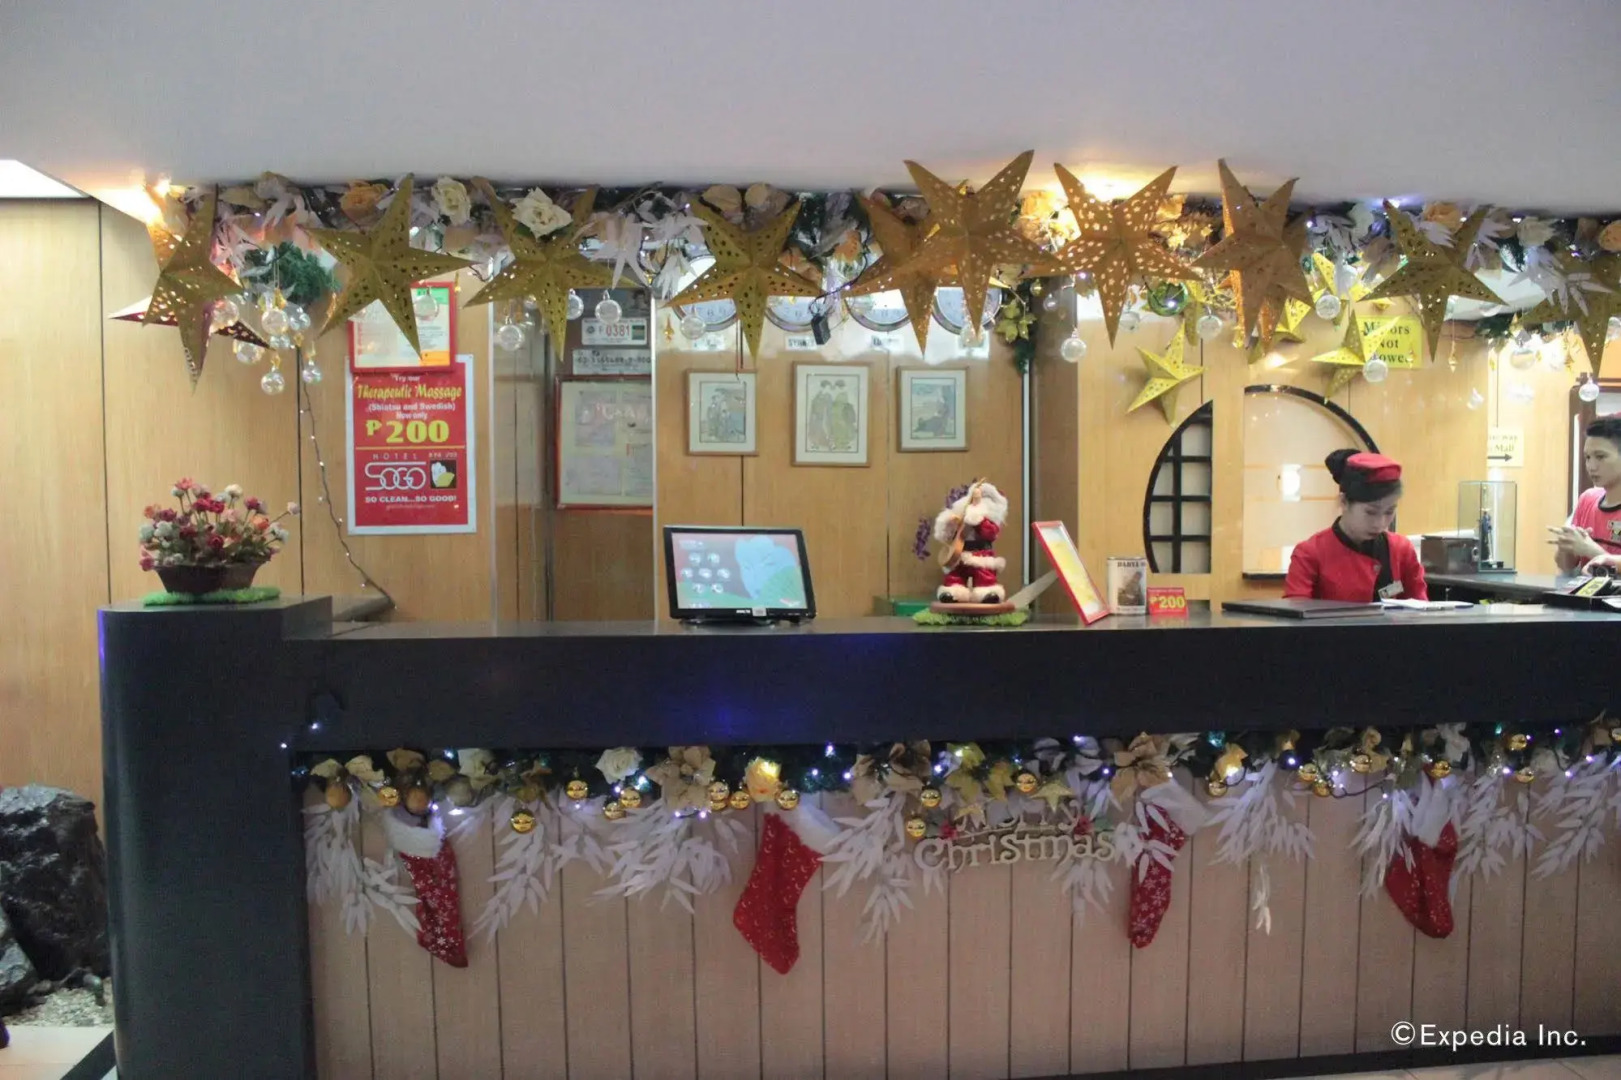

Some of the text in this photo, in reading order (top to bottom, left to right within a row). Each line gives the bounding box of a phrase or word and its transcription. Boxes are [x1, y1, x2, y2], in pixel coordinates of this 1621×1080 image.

[606, 325, 630, 336] 0381
[1363, 321, 1410, 336] Mors
[358, 383, 462, 401] Therapeutic Massage
[368, 403, 401, 412] (Shiatsu
[420, 402, 455, 411] Swedish)
[373, 452, 418, 460] HOTEL
[364, 461, 427, 492] SOGO
[914, 832, 1115, 873] Christmas
